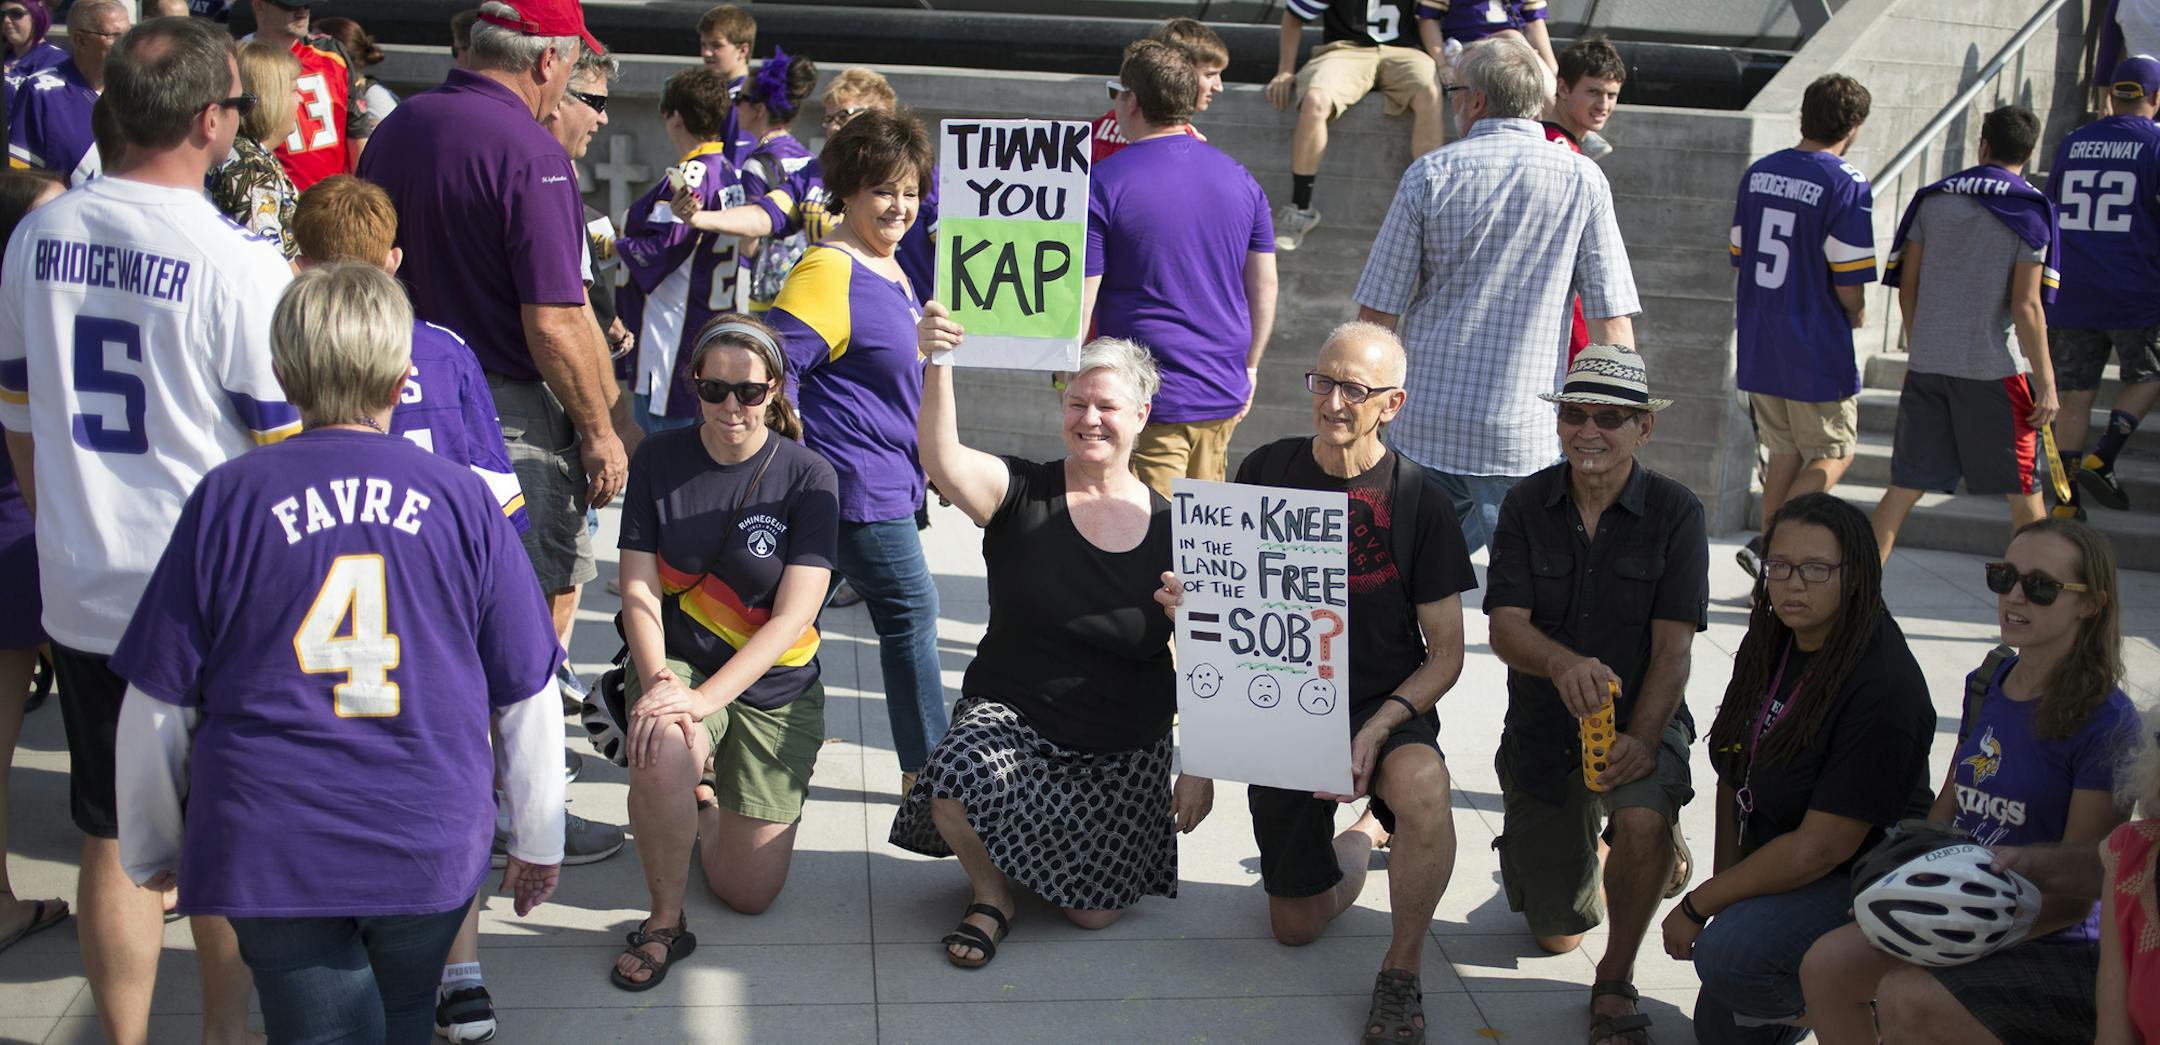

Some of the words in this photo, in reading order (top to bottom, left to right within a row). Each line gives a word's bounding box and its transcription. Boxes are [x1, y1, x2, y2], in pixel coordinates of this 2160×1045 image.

[947, 122, 1090, 175] THANK
[1839, 162, 1867, 183] 5
[2069, 140, 2144, 160] GREENWAY
[966, 178, 1066, 220] YOU
[1749, 172, 1824, 206] BRIDGEWATER
[1942, 177, 2011, 196] SMITH
[2059, 170, 2137, 232] 52
[35, 239, 190, 302] BRIDGEWATER
[1755, 207, 1796, 289] 5
[951, 235, 1070, 316] KAP
[72, 314, 148, 454] 5
[271, 478, 430, 545] FAVRE
[738, 514, 788, 533] RHINEGEIST
[1173, 493, 1234, 527] TAKE
[1241, 511, 1255, 531] A
[1260, 496, 1344, 543] KNEE
[1180, 537, 1195, 550] IN
[1202, 540, 1233, 556] THE
[1182, 555, 1247, 581] LAND
[1183, 580, 1204, 593] OF
[1210, 581, 1246, 599] THE
[1258, 551, 1346, 607] FREE
[293, 553, 400, 718] 4
